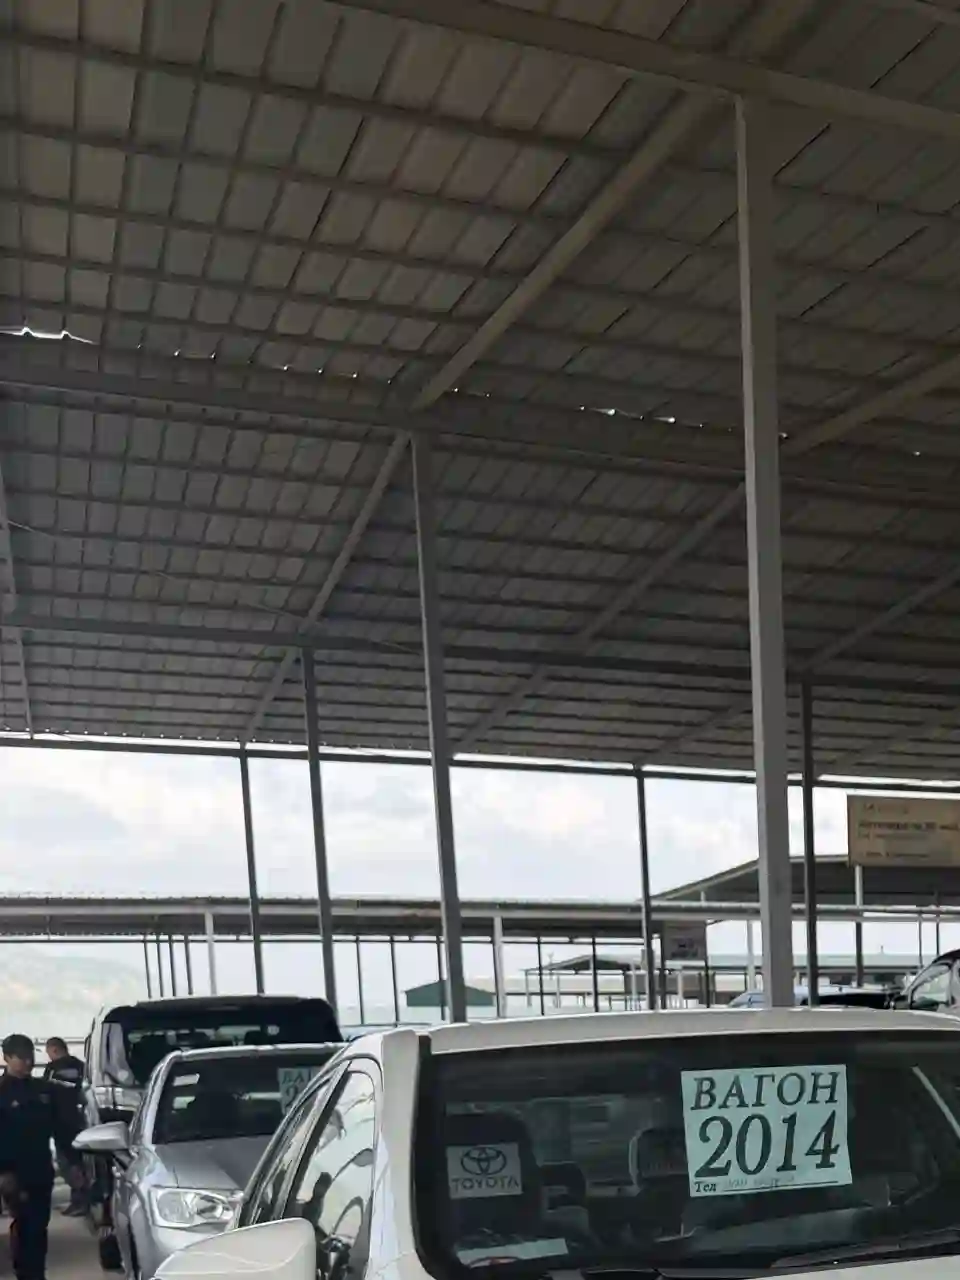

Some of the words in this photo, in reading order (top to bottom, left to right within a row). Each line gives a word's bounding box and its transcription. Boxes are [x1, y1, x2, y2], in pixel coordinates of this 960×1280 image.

[690, 1071, 839, 1111] ВАГОН
[694, 1110, 840, 1178] 2014
[451, 1174, 520, 1192] TOYOTA
